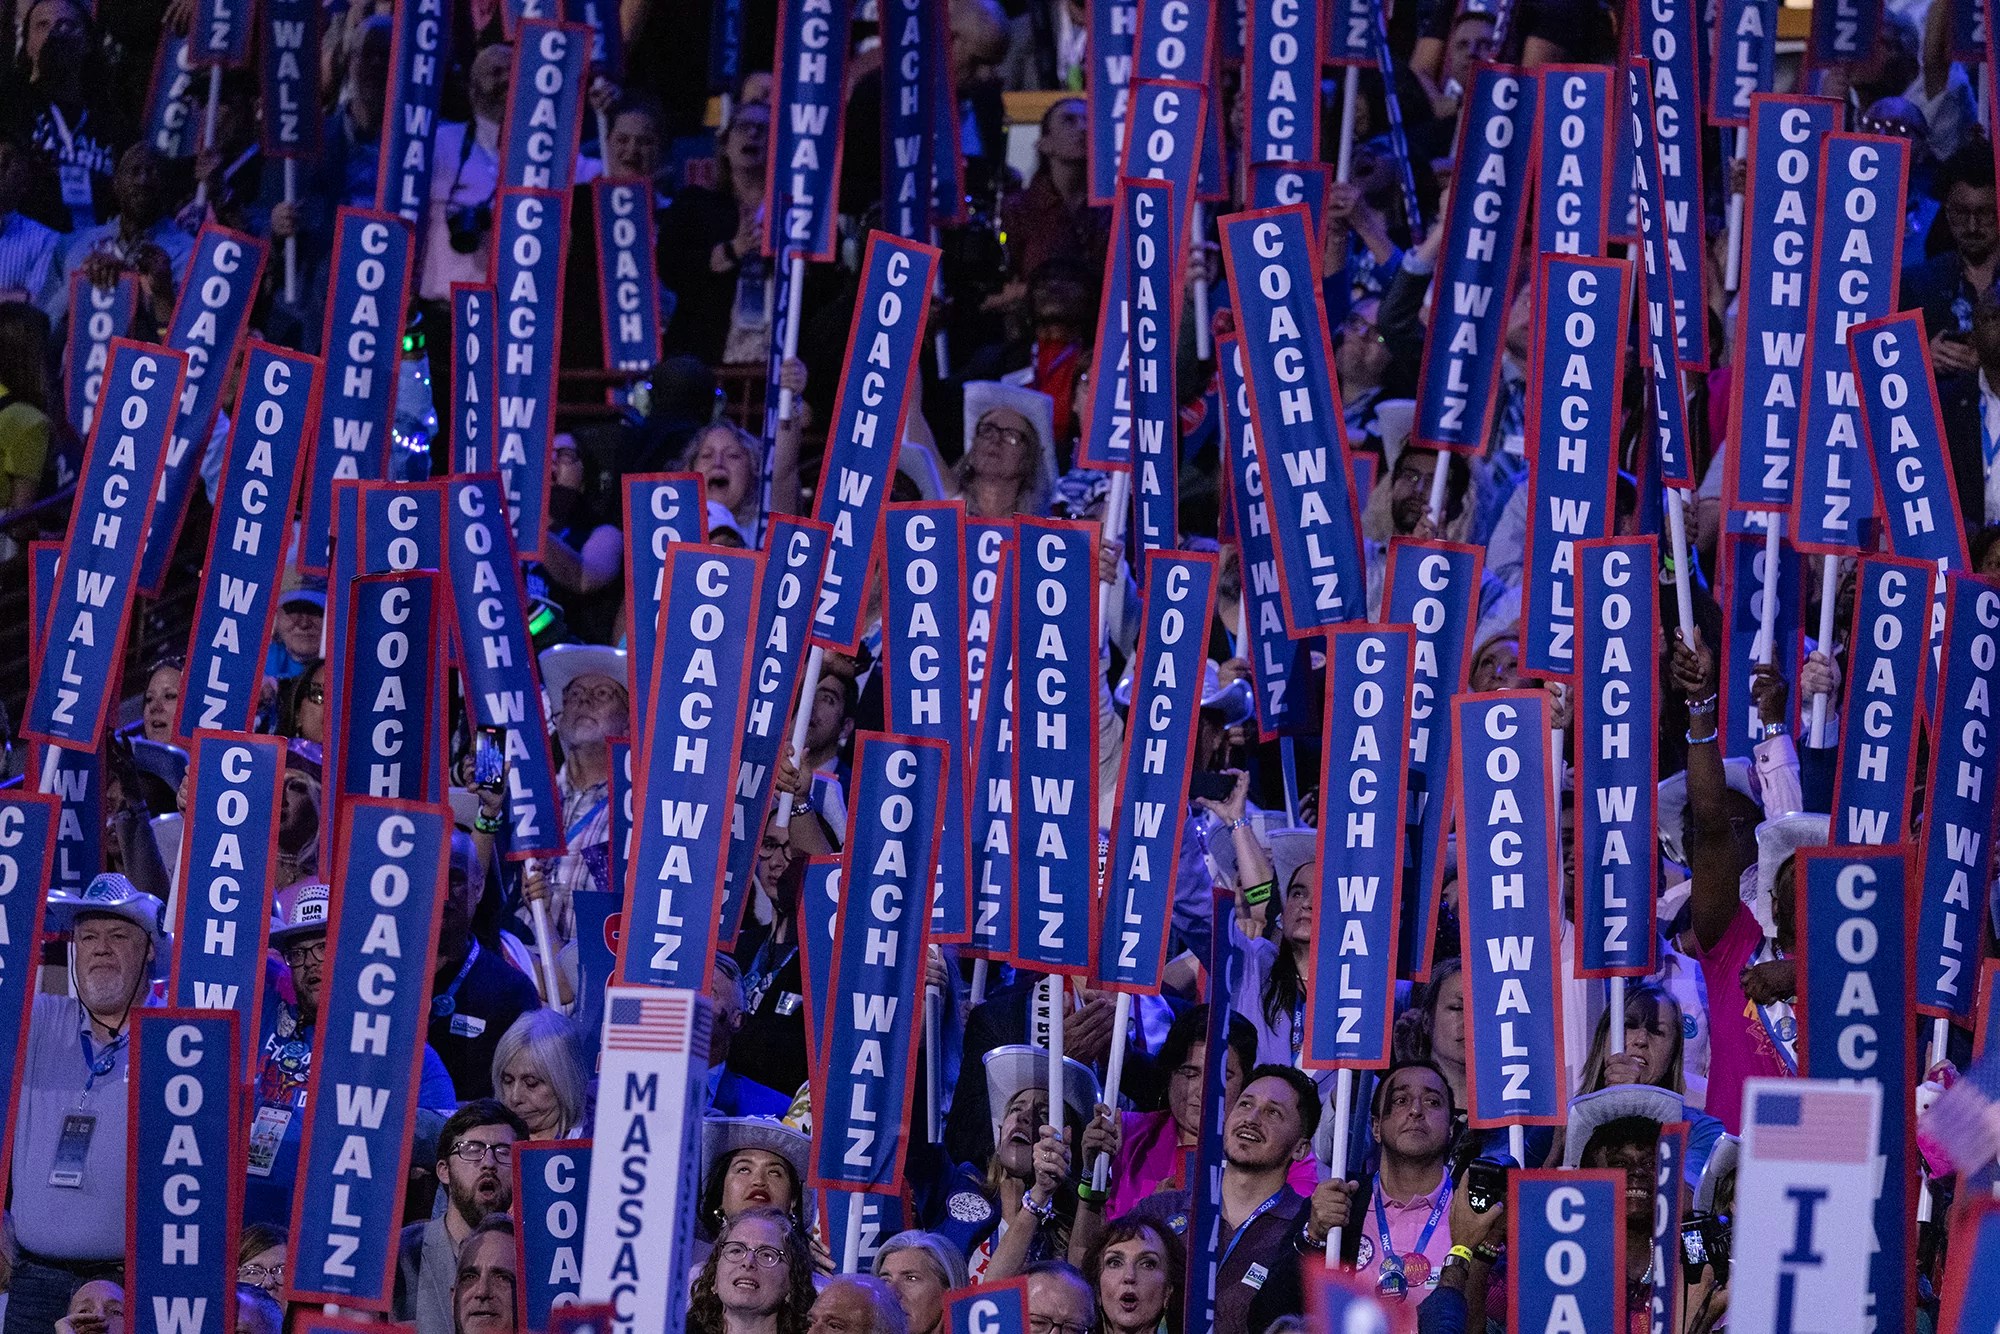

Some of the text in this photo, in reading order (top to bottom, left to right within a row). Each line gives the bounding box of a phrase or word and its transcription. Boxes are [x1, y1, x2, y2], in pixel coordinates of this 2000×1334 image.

[210, 0, 231, 49] LZ
[274, 21, 305, 142] WALZ
[523, 31, 566, 188] COACH
[1652, 0, 1681, 177] COACH
[1734, 6, 1764, 108] ALZ
[612, 188, 643, 343] COACH
[791, 104, 828, 240] WALZ
[895, 135, 921, 238] WAL
[1439, 78, 1519, 430] COACH WALZ
[1556, 77, 1587, 255] COACH
[333, 224, 389, 480] COACH WA
[466, 295, 480, 474] COACH
[507, 198, 543, 375] COACH
[1136, 193, 1165, 550] COACH WAL
[1253, 223, 1313, 426] COACH
[1762, 109, 1811, 489] COACH WALZ
[1823, 146, 1880, 530] COACH WALZ
[815, 252, 910, 626] COACH WALZ
[1282, 448, 1343, 610] WALZ
[1549, 271, 1598, 659] COACH WALZ
[1873, 332, 1935, 537] COACH
[52, 357, 158, 725] COACH WALZ
[199, 361, 291, 731] COACH WALZ
[748, 532, 811, 737] COACH
[906, 516, 941, 725] COACH
[1251, 560, 1287, 716] WALZ
[370, 587, 411, 799] COACH
[459, 486, 540, 838] COACH WALZ
[1031, 535, 1075, 949] COACH WALZ
[1597, 551, 1638, 952] COACH WALZ
[1858, 571, 1907, 783] COACH
[52, 769, 89, 898] WAL
[204, 747, 253, 957] COACH
[650, 561, 730, 972] COACH WALZ
[865, 750, 917, 967] COACH
[976, 779, 1013, 936] WALZ
[1118, 566, 1191, 968] COACH WALZ
[1336, 638, 1386, 1044] COACH WALZ
[1936, 591, 2000, 996] COACH WALZ
[302, 904, 322, 915] WA
[1485, 705, 1534, 1101] COACH WALZ
[1837, 866, 1879, 1088] COAC
[163, 1025, 204, 1265] COACH
[324, 815, 416, 1278] COACH WALZ
[844, 993, 899, 1167] WALZ
[545, 1155, 582, 1309] COA
[1242, 1199, 1276, 1229] DNC 2024
[1247, 1270, 1266, 1282] DelB
[1381, 1233, 1390, 1251] DNC
[1429, 1208, 1441, 1227] DNC
[1471, 1196, 1486, 1209] 3.4
[1545, 1188, 1587, 1334] COA
